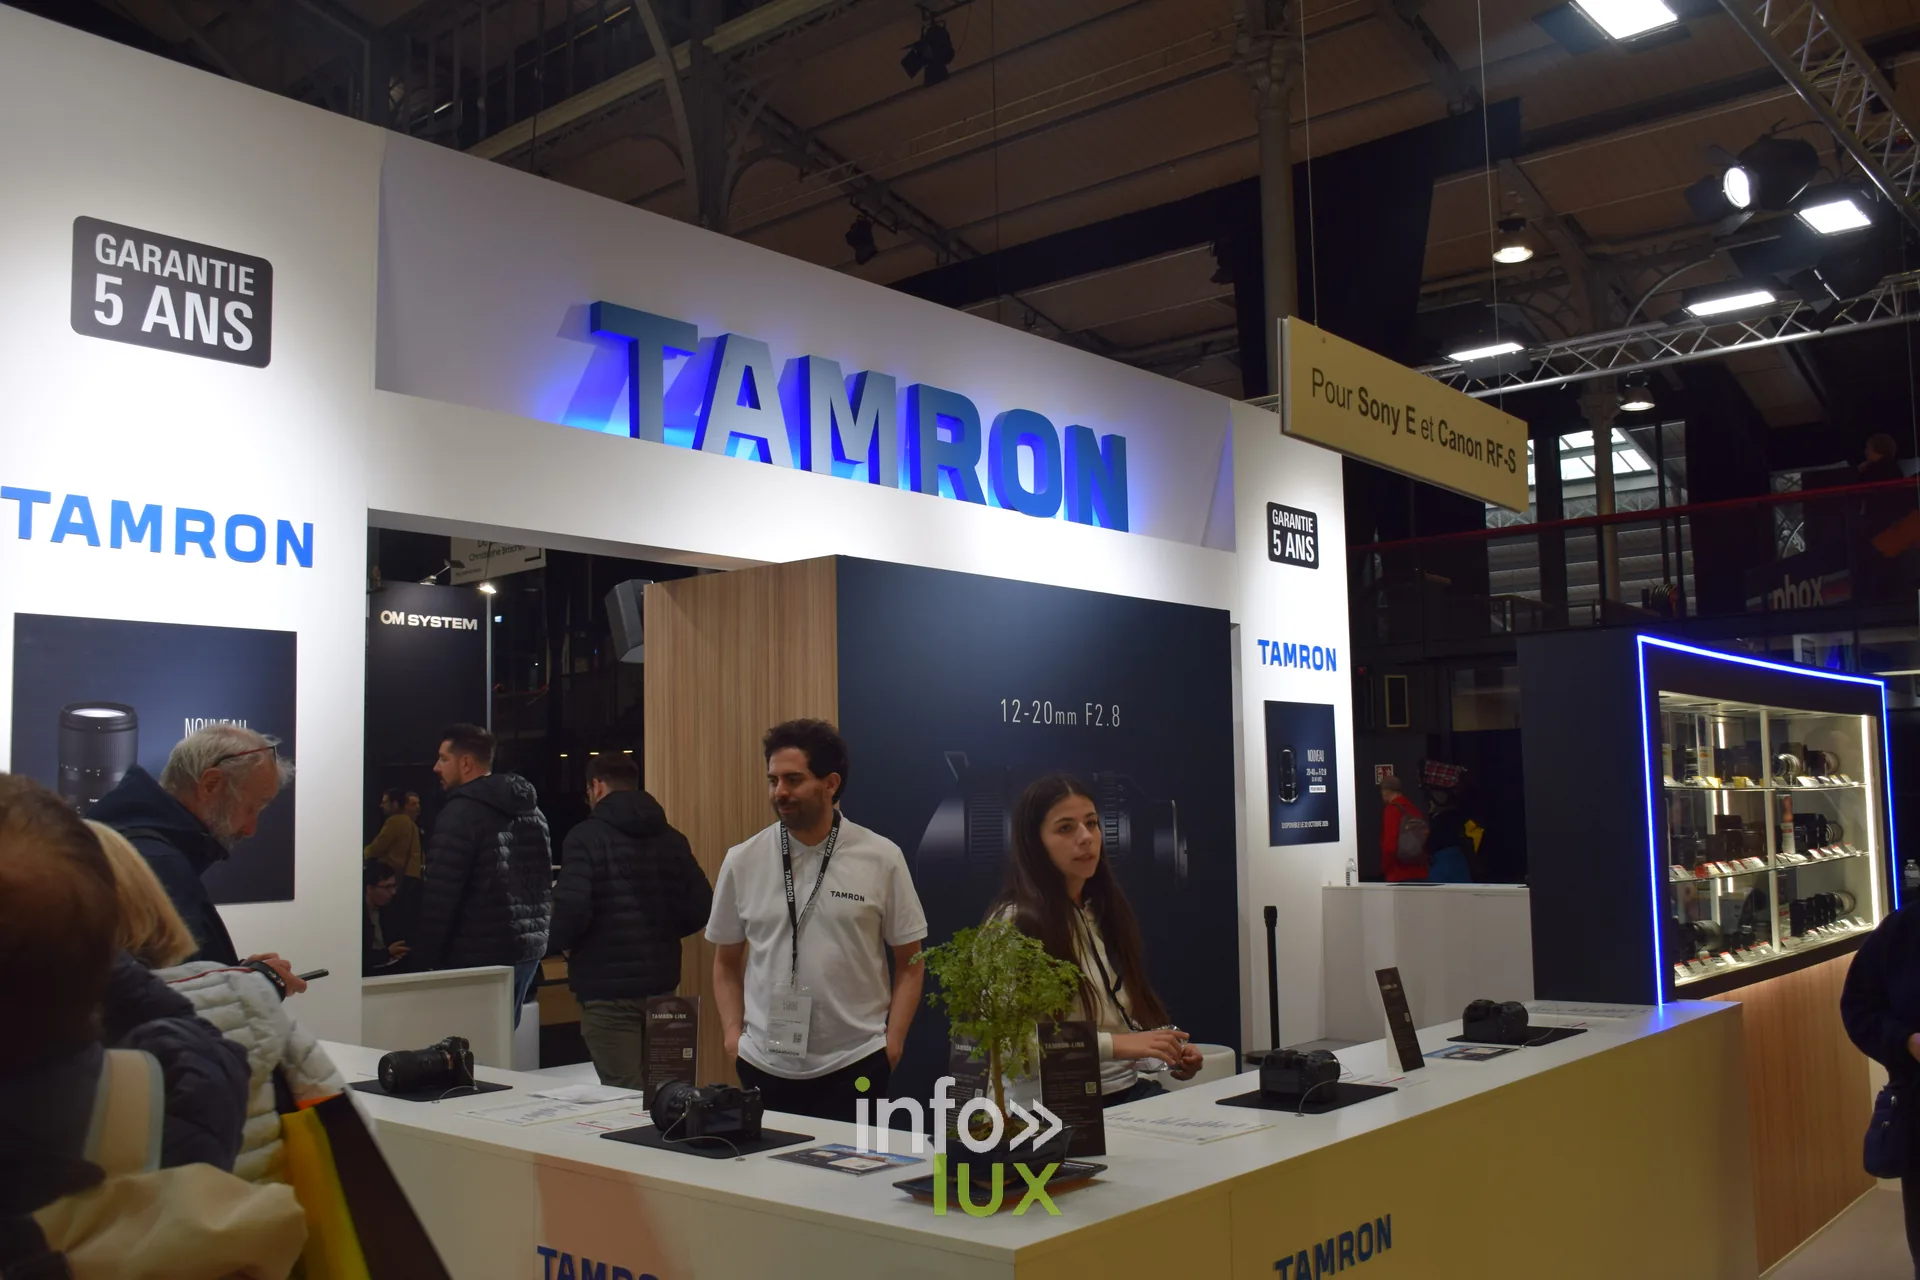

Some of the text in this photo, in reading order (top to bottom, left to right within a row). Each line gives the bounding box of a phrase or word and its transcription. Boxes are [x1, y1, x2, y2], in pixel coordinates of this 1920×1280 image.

[94, 233, 256, 297] GARANTIE
[93, 272, 253, 352] 5 ANS
[590, 300, 1128, 532] TAMRON
[1311, 366, 1517, 474] Pour Sony E et Canon RF-S
[0, 485, 314, 569] TAMRON
[1271, 508, 1314, 534] GARANTIE
[1273, 529, 1316, 563] 5 ANS
[381, 611, 478, 631] OM SYSTEM
[1258, 640, 1336, 671] TAMRON
[1000, 698, 1121, 727] 12-20mm F2.8
[825, 826, 838, 858] TAMRON
[785, 869, 795, 904] TAMRON
[830, 890, 865, 903] TAMRON
[1273, 1213, 1392, 1280] TAMRON
